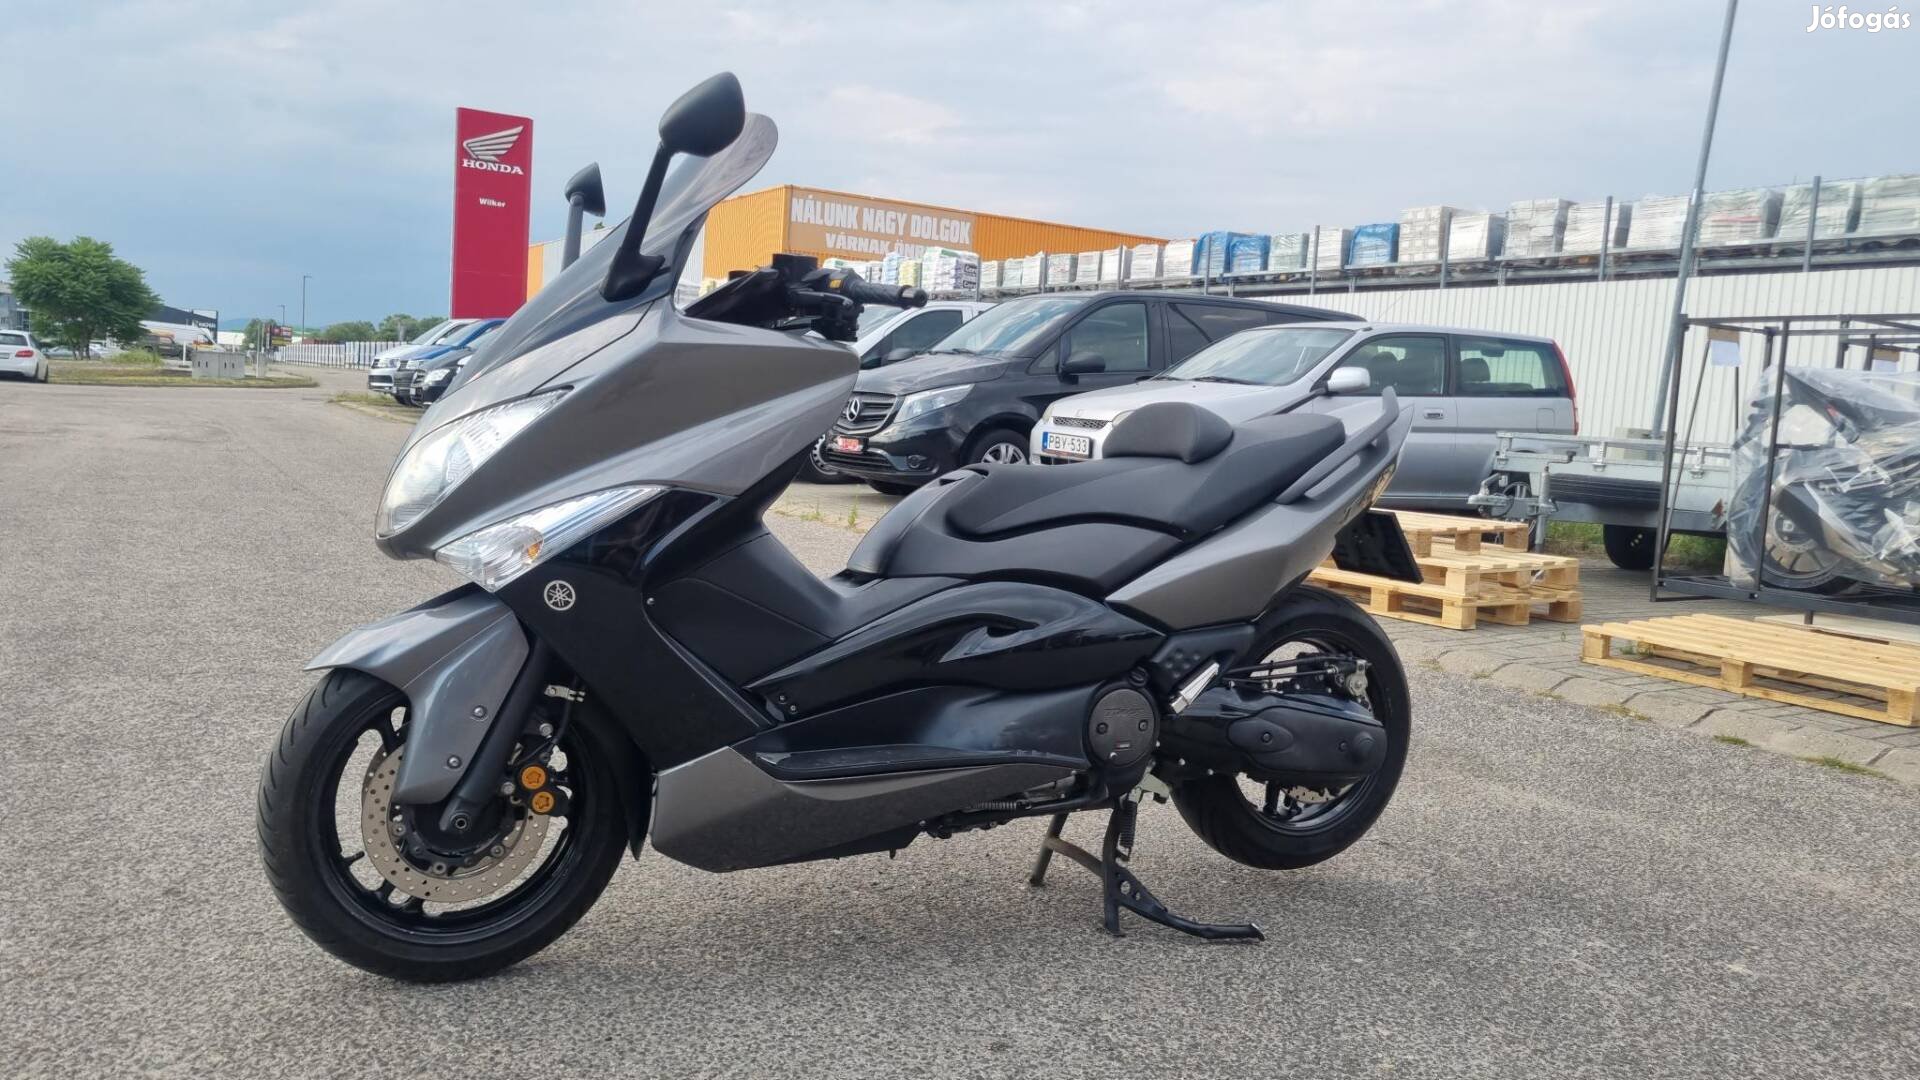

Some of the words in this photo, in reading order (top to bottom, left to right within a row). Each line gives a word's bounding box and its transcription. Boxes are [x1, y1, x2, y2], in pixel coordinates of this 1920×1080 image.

[462, 158, 524, 175] HONDA
[479, 197, 506, 208] Wilker
[791, 194, 859, 230] NÁLUNK
[863, 207, 908, 236] NAGY
[910, 214, 972, 244] DOLGOK
[826, 231, 890, 254] VÁRNAK
[894, 239, 926, 258] ÖNR
